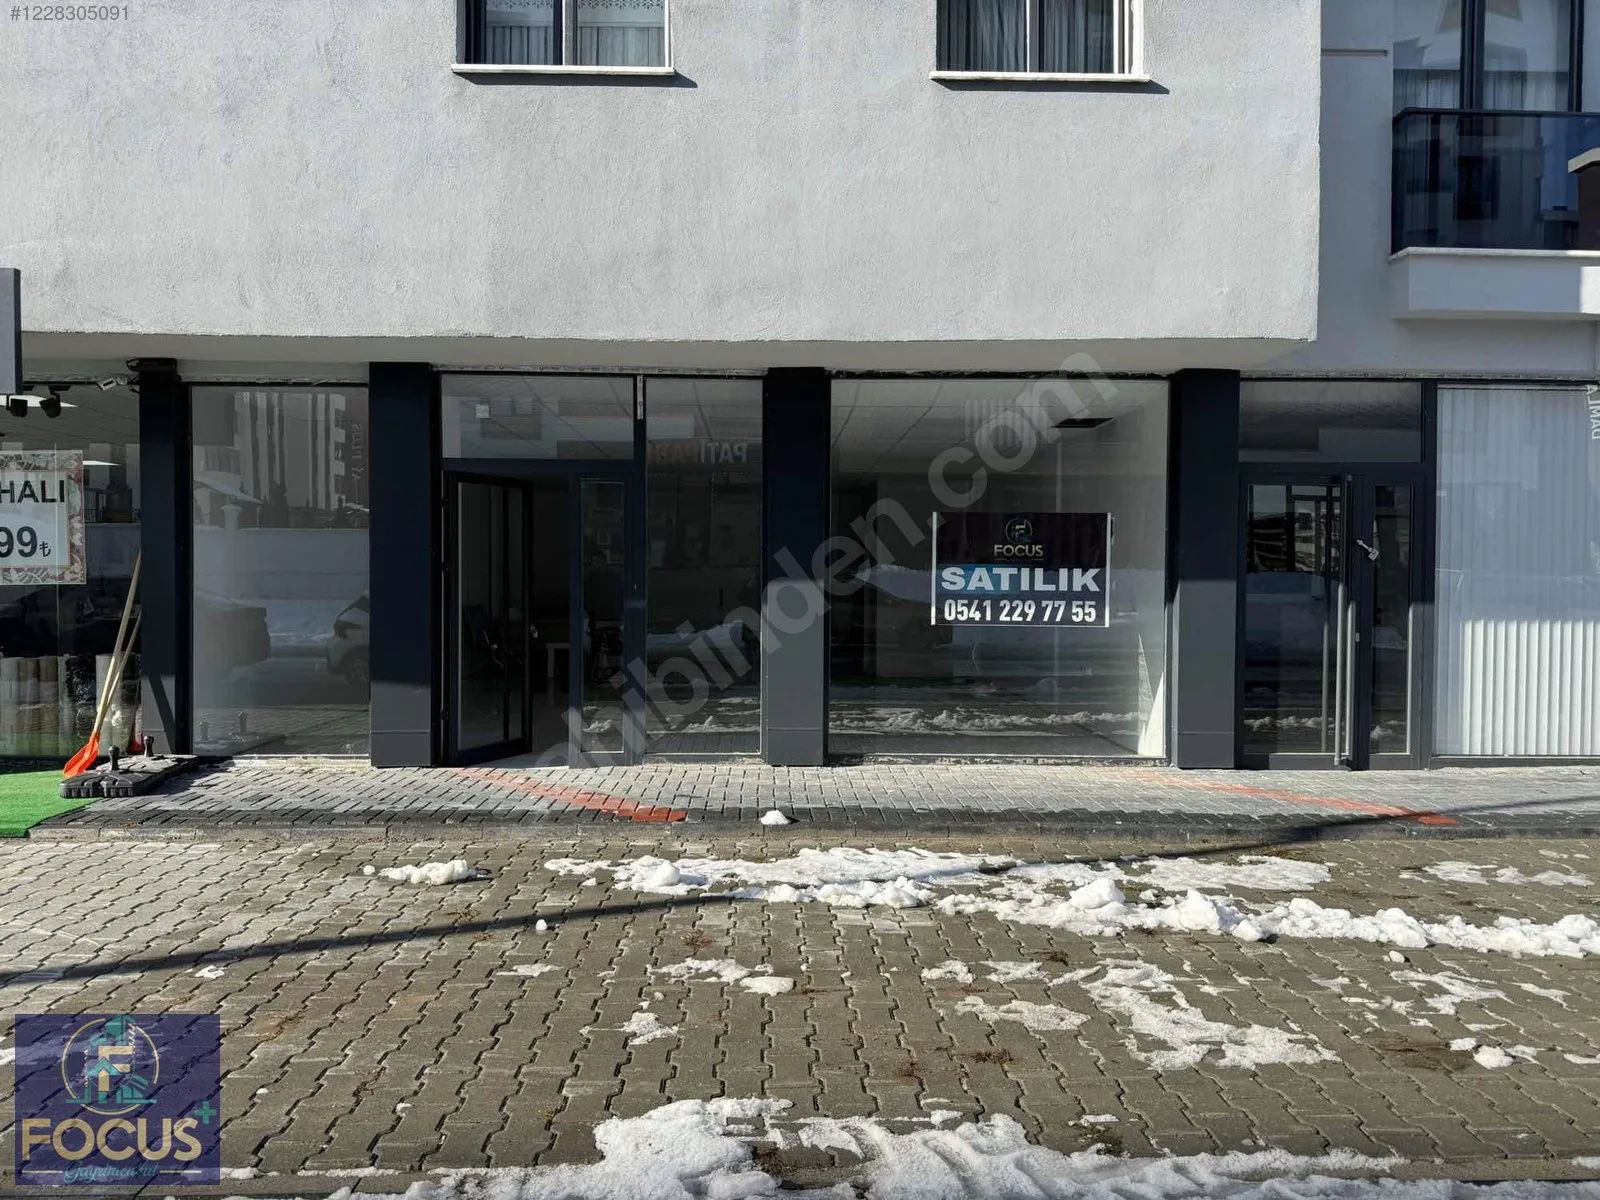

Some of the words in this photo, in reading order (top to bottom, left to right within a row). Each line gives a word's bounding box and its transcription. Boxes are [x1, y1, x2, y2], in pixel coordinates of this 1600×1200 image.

[993, 544, 1043, 557] FOCUS
[941, 567, 1101, 592] SATILIK
[944, 599, 992, 621] 0541
[1000, 600, 1036, 622] 229
[1042, 600, 1066, 622] 77
[1071, 601, 1096, 622] 55
